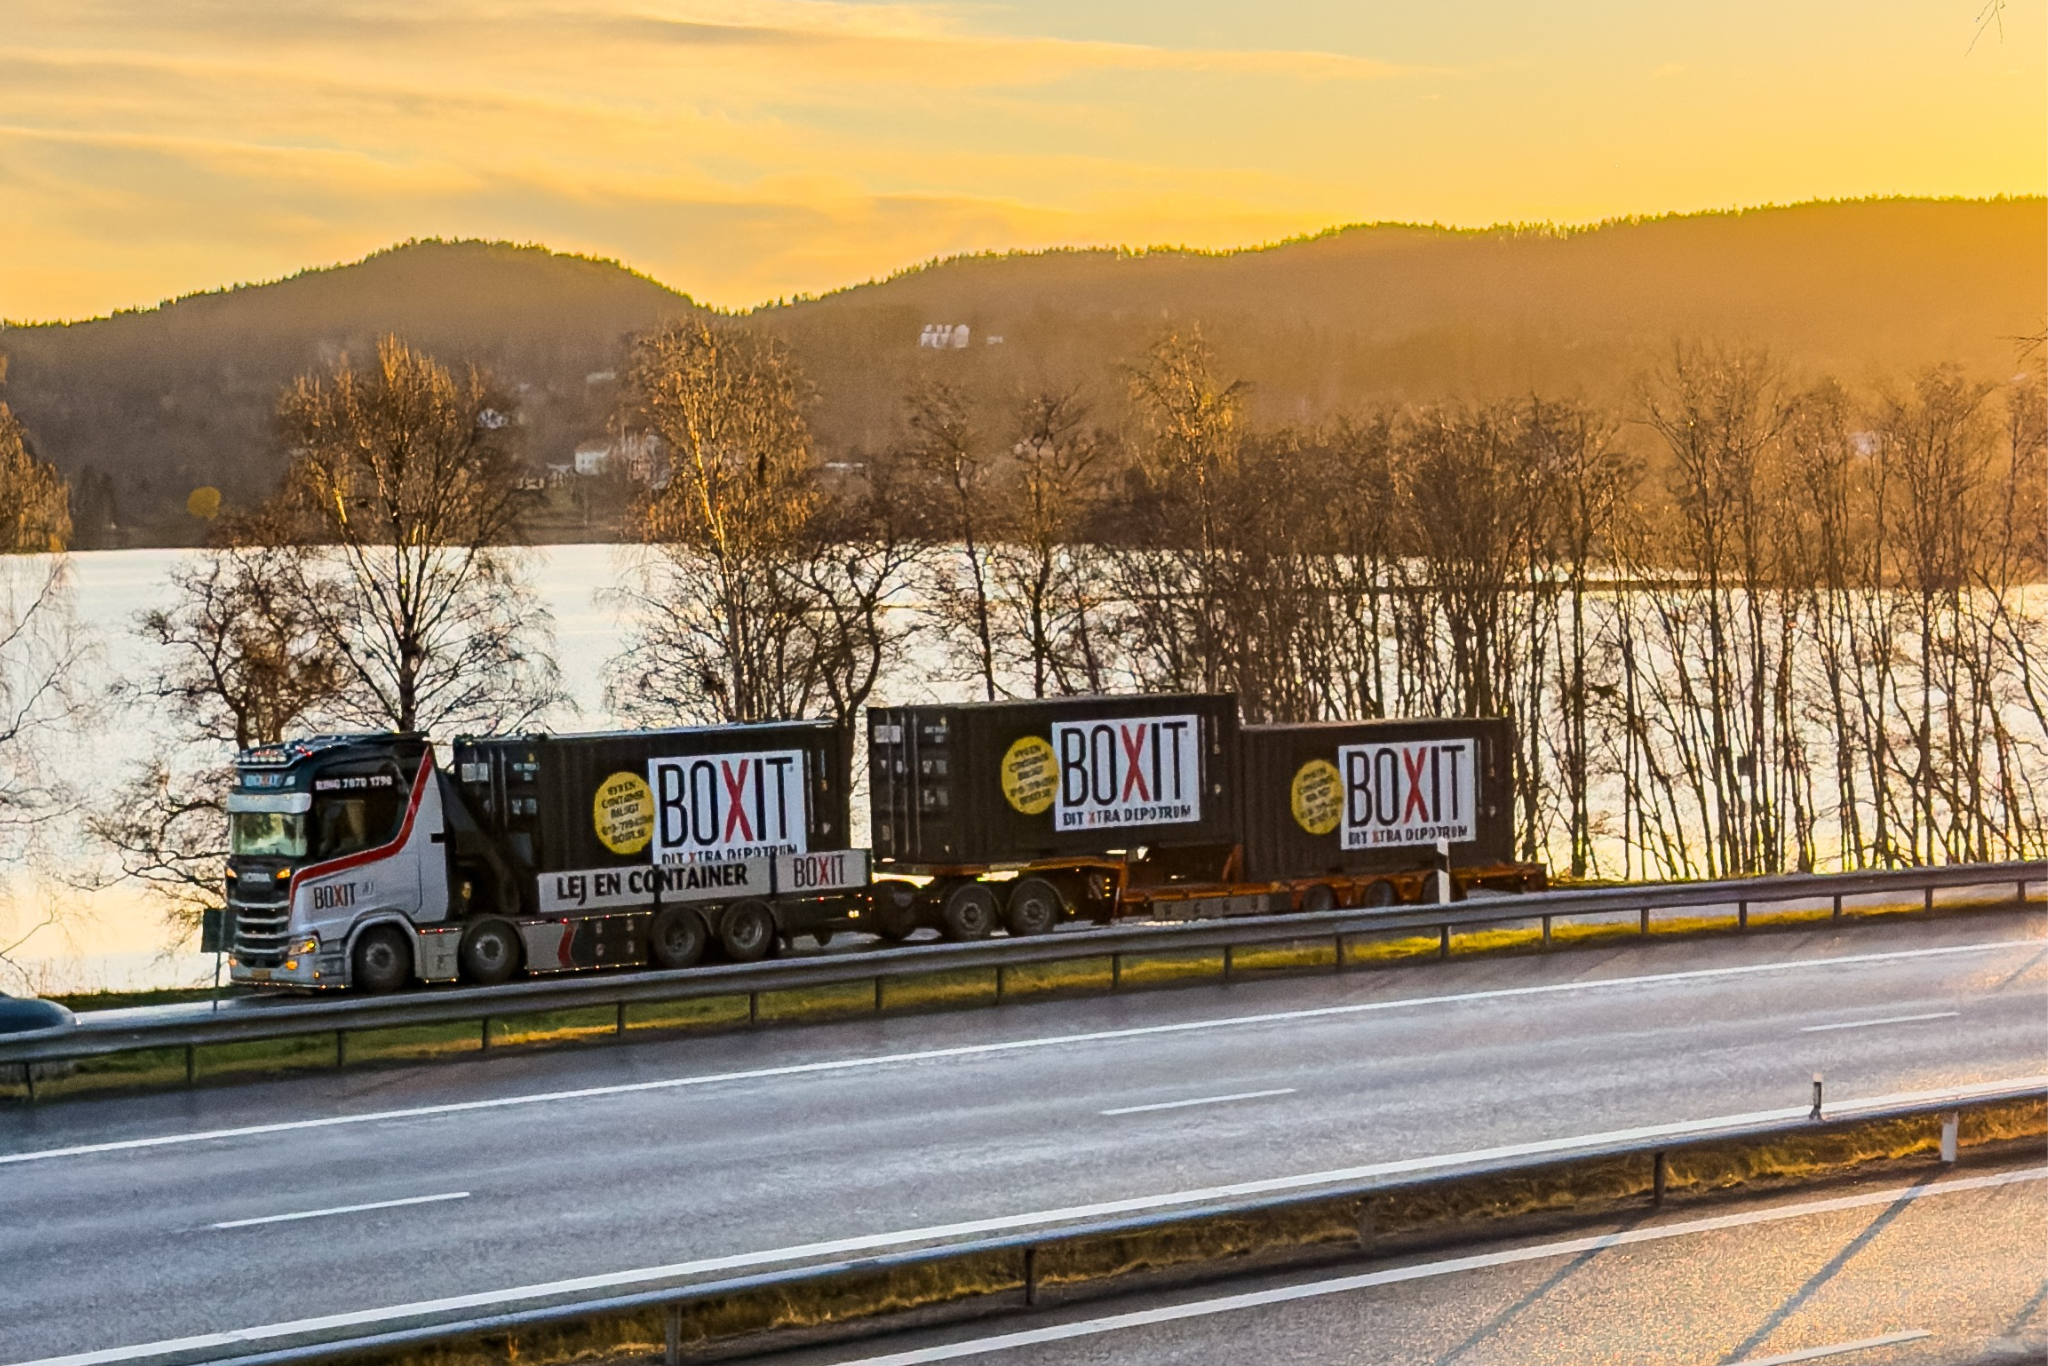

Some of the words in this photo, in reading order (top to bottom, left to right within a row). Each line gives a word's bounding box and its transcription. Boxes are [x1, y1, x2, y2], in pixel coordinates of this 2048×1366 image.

[1061, 722, 1187, 808] BOXIT
[658, 757, 793, 848] BOXIT
[1346, 745, 1466, 828] BOXIT
[1062, 811, 1084, 826] DIT
[1088, 808, 1121, 823] XTRA
[1124, 804, 1192, 821] DEPOTRUM
[1372, 828, 1402, 843] XTRA
[556, 875, 588, 907] LEJ
[594, 872, 622, 898] EN
[628, 863, 749, 894] CONTAINER
[793, 854, 845, 888] BOXIT
[313, 882, 357, 910] BOXIT
